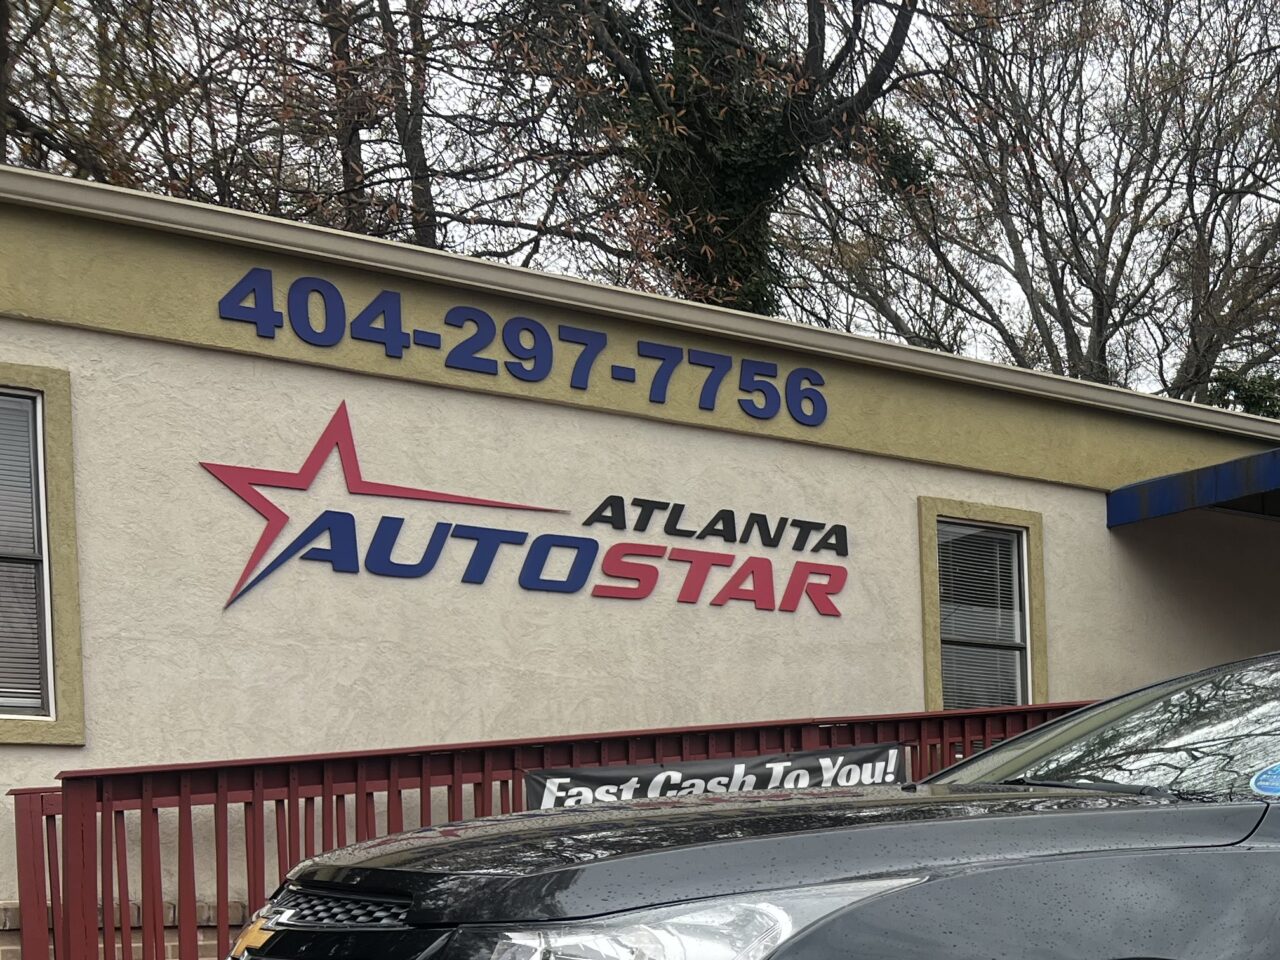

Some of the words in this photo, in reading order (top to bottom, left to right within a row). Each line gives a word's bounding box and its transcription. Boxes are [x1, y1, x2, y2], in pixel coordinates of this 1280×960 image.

[218, 266, 829, 428] 404-297-7756
[582, 494, 850, 557] ATLANTA
[540, 776, 641, 810] Fast
[647, 763, 757, 799] Cash
[765, 761, 810, 790] To
[818, 748, 898, 788] You!
